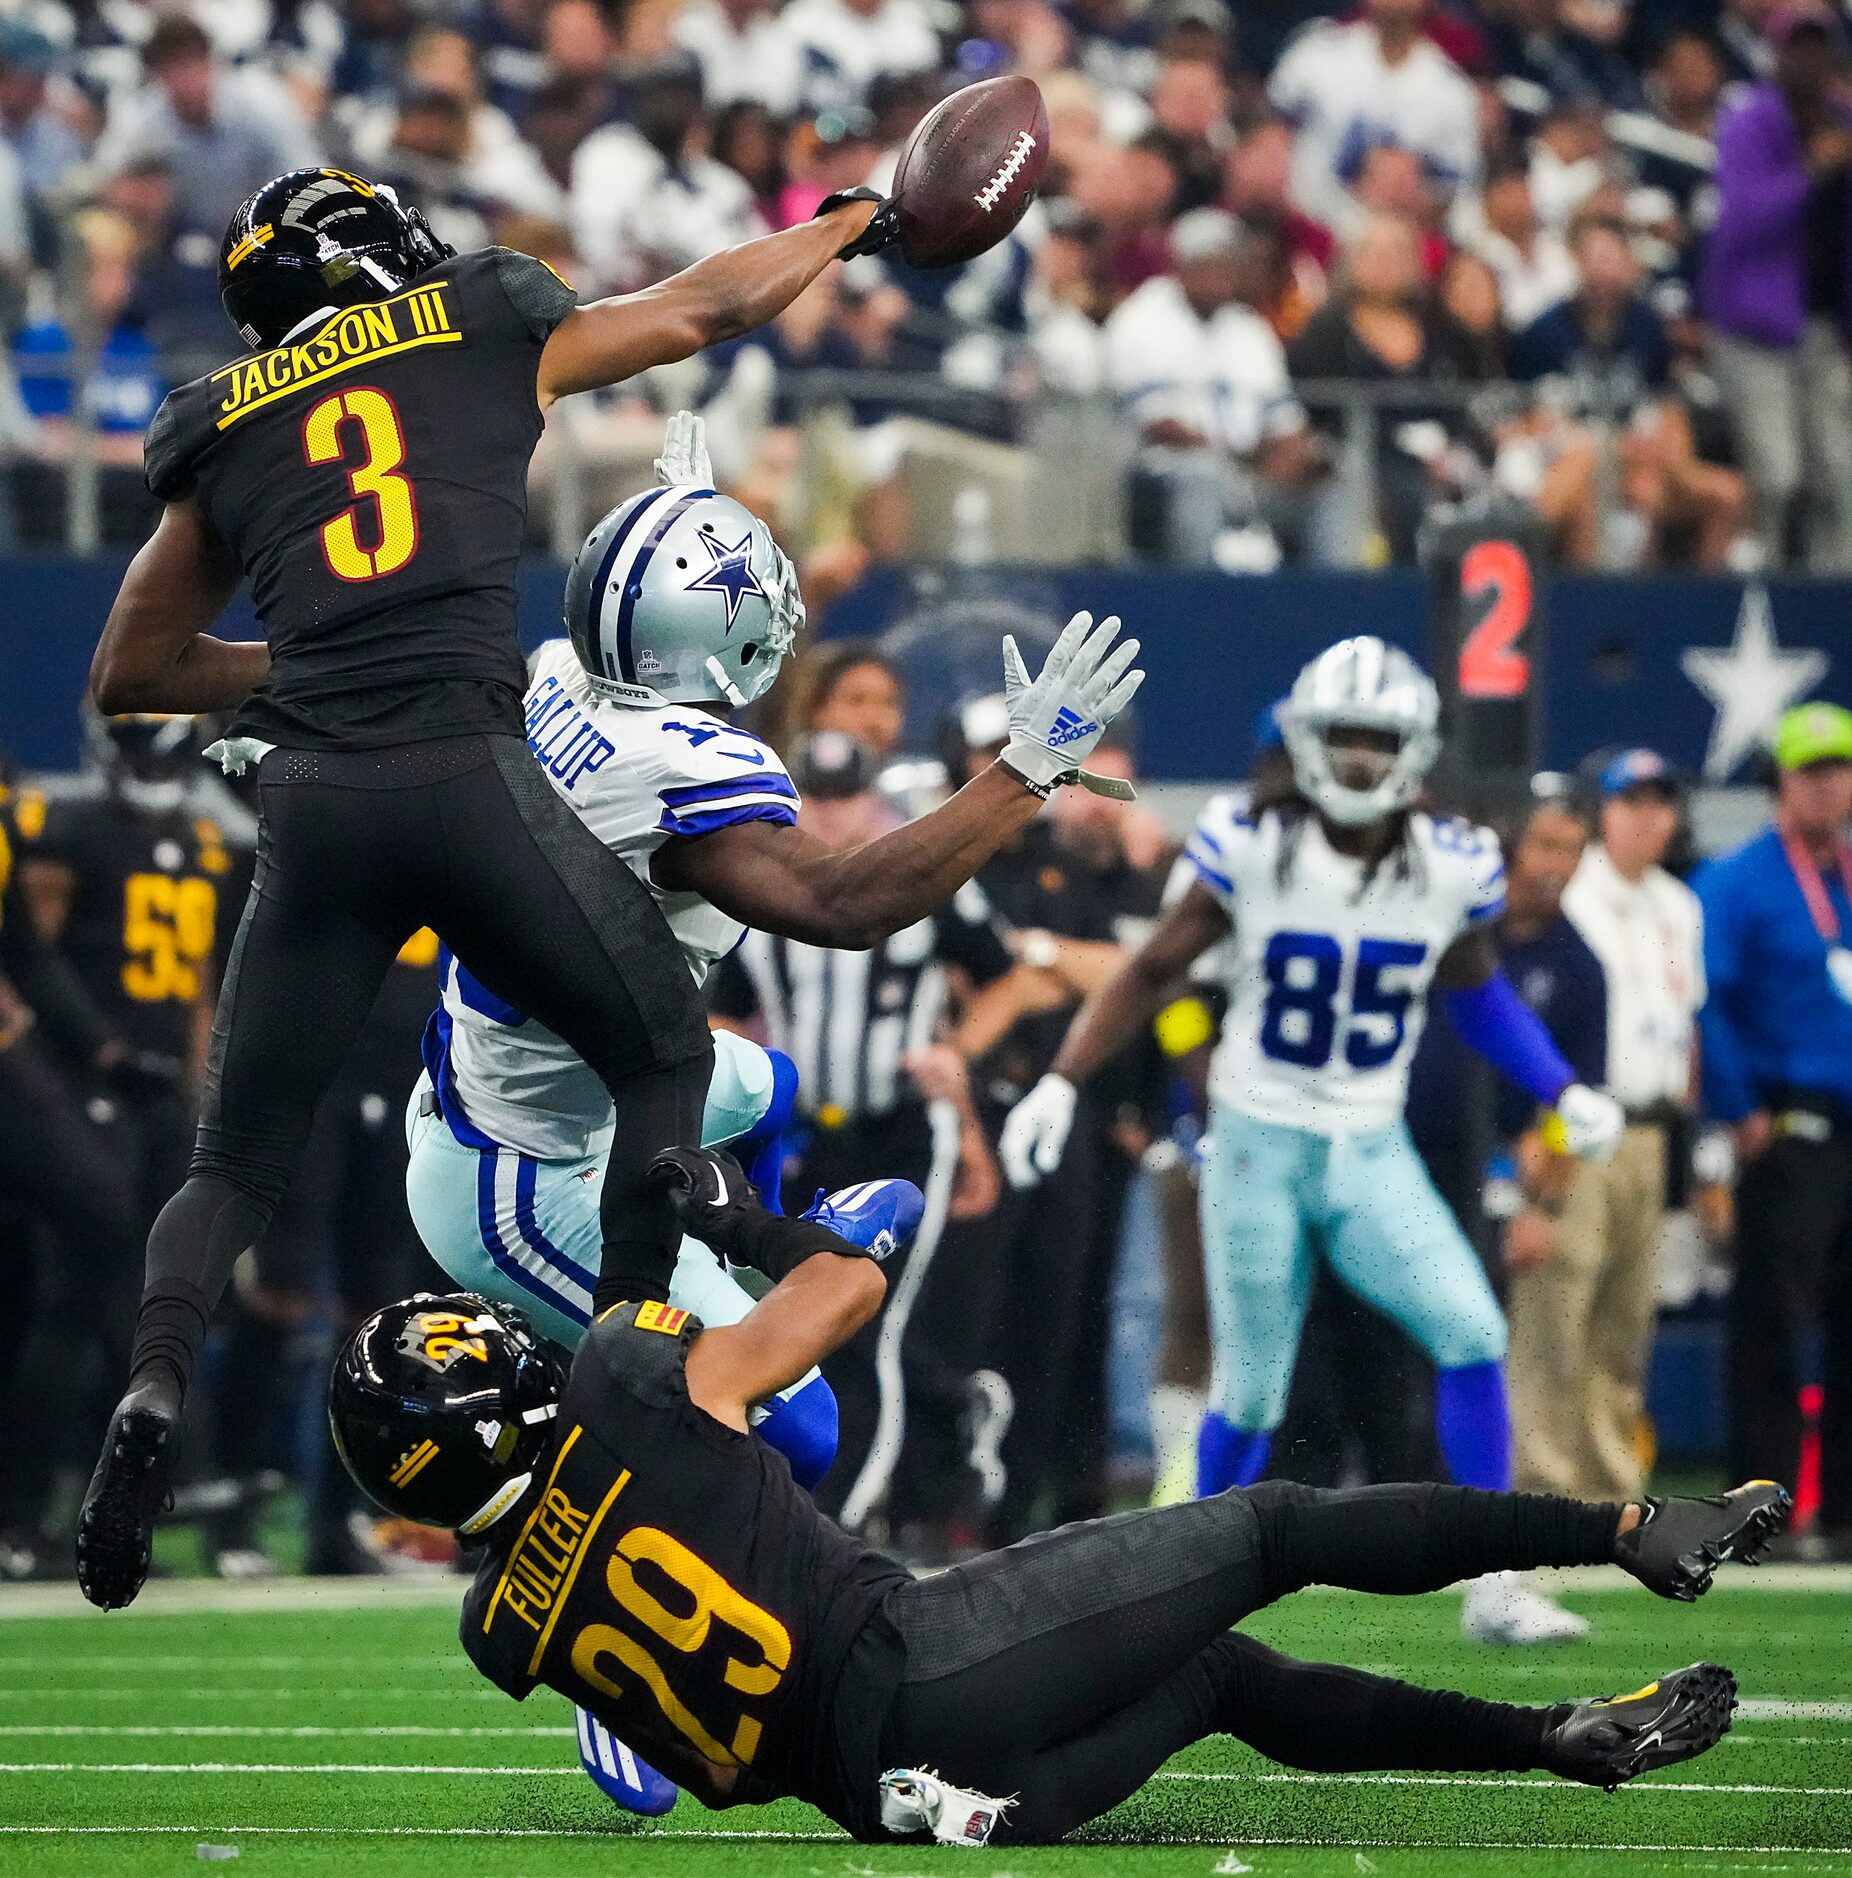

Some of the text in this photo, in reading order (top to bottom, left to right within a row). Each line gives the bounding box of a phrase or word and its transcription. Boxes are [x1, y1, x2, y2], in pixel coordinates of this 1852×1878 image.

[220, 291, 450, 413] JACKSON III
[303, 386, 420, 582] 3
[1458, 539, 1532, 698] 2
[524, 676, 616, 790] GALLUP
[1047, 721, 1098, 747] adidas
[1261, 928, 1428, 1070] 85
[419, 1313, 489, 1364] 29
[503, 1487, 590, 1631] FULLER
[571, 1526, 792, 1766] 29
